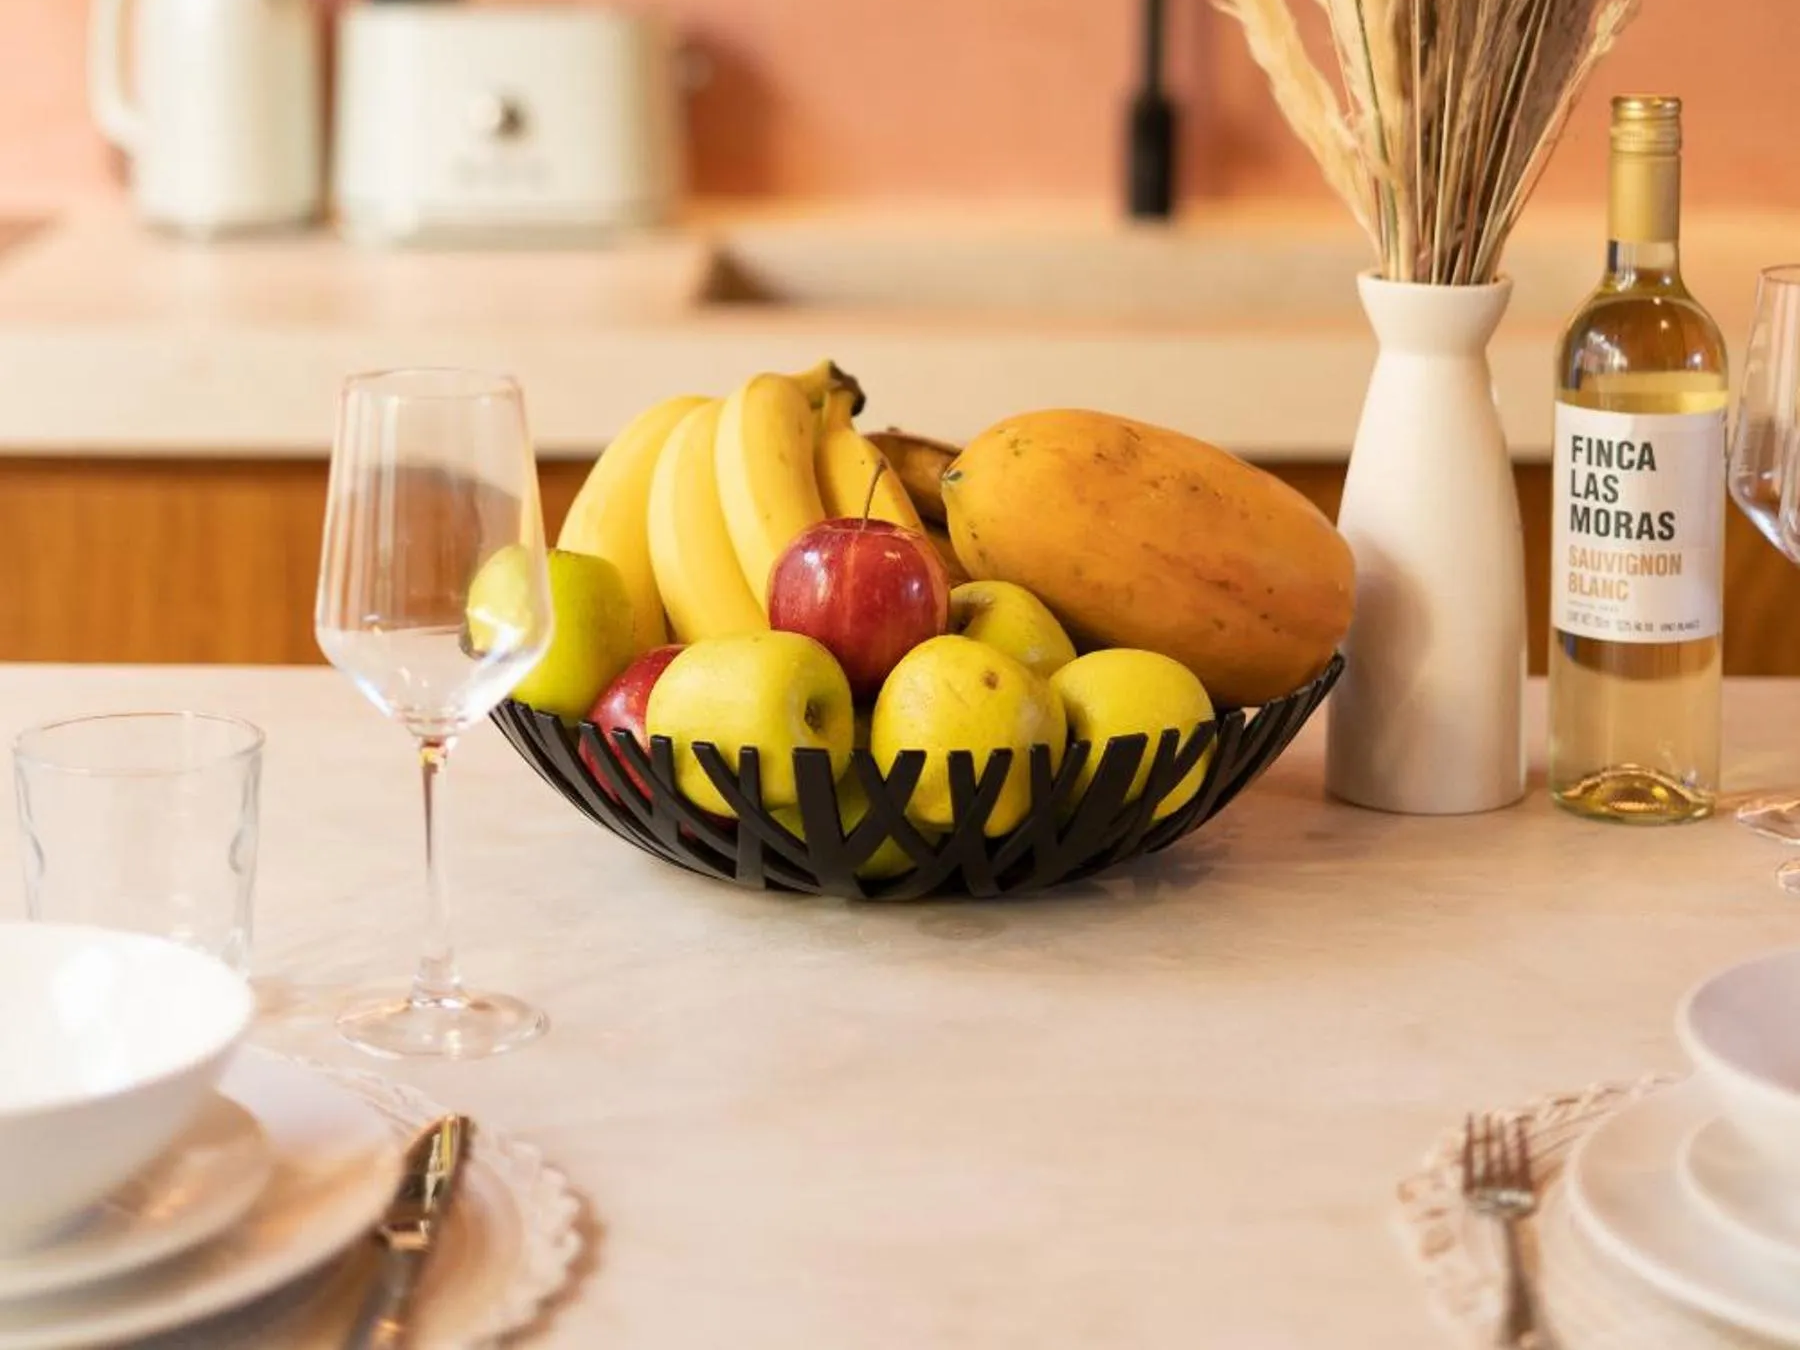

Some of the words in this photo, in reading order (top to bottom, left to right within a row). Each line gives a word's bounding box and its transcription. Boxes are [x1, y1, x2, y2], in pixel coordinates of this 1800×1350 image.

[1571, 435, 1657, 471] FINCA
[1570, 468, 1619, 503] LAS
[1569, 504, 1675, 541] MORAS
[1568, 546, 1682, 576] SAUVIGNON
[1568, 572, 1629, 600] BLANC
